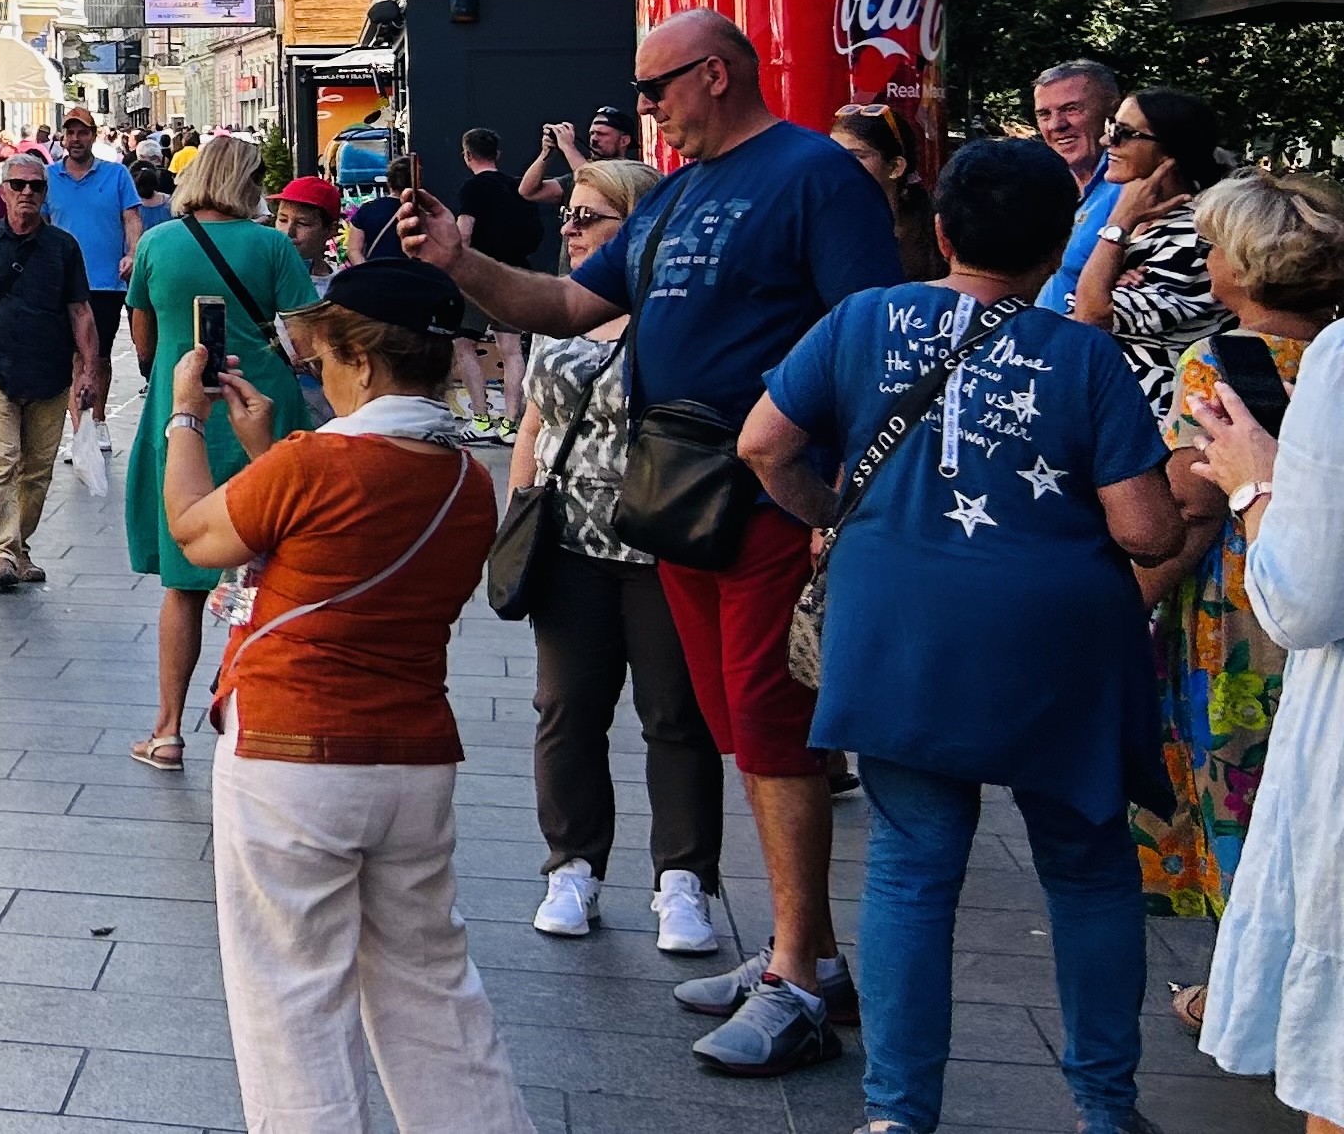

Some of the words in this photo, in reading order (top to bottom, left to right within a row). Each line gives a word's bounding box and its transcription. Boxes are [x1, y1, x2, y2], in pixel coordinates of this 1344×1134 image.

[886, 82, 921, 99] Real
[888, 302, 928, 334] We
[981, 334, 1054, 372] those
[884, 350, 912, 372] the
[852, 416, 907, 488] GUESS
